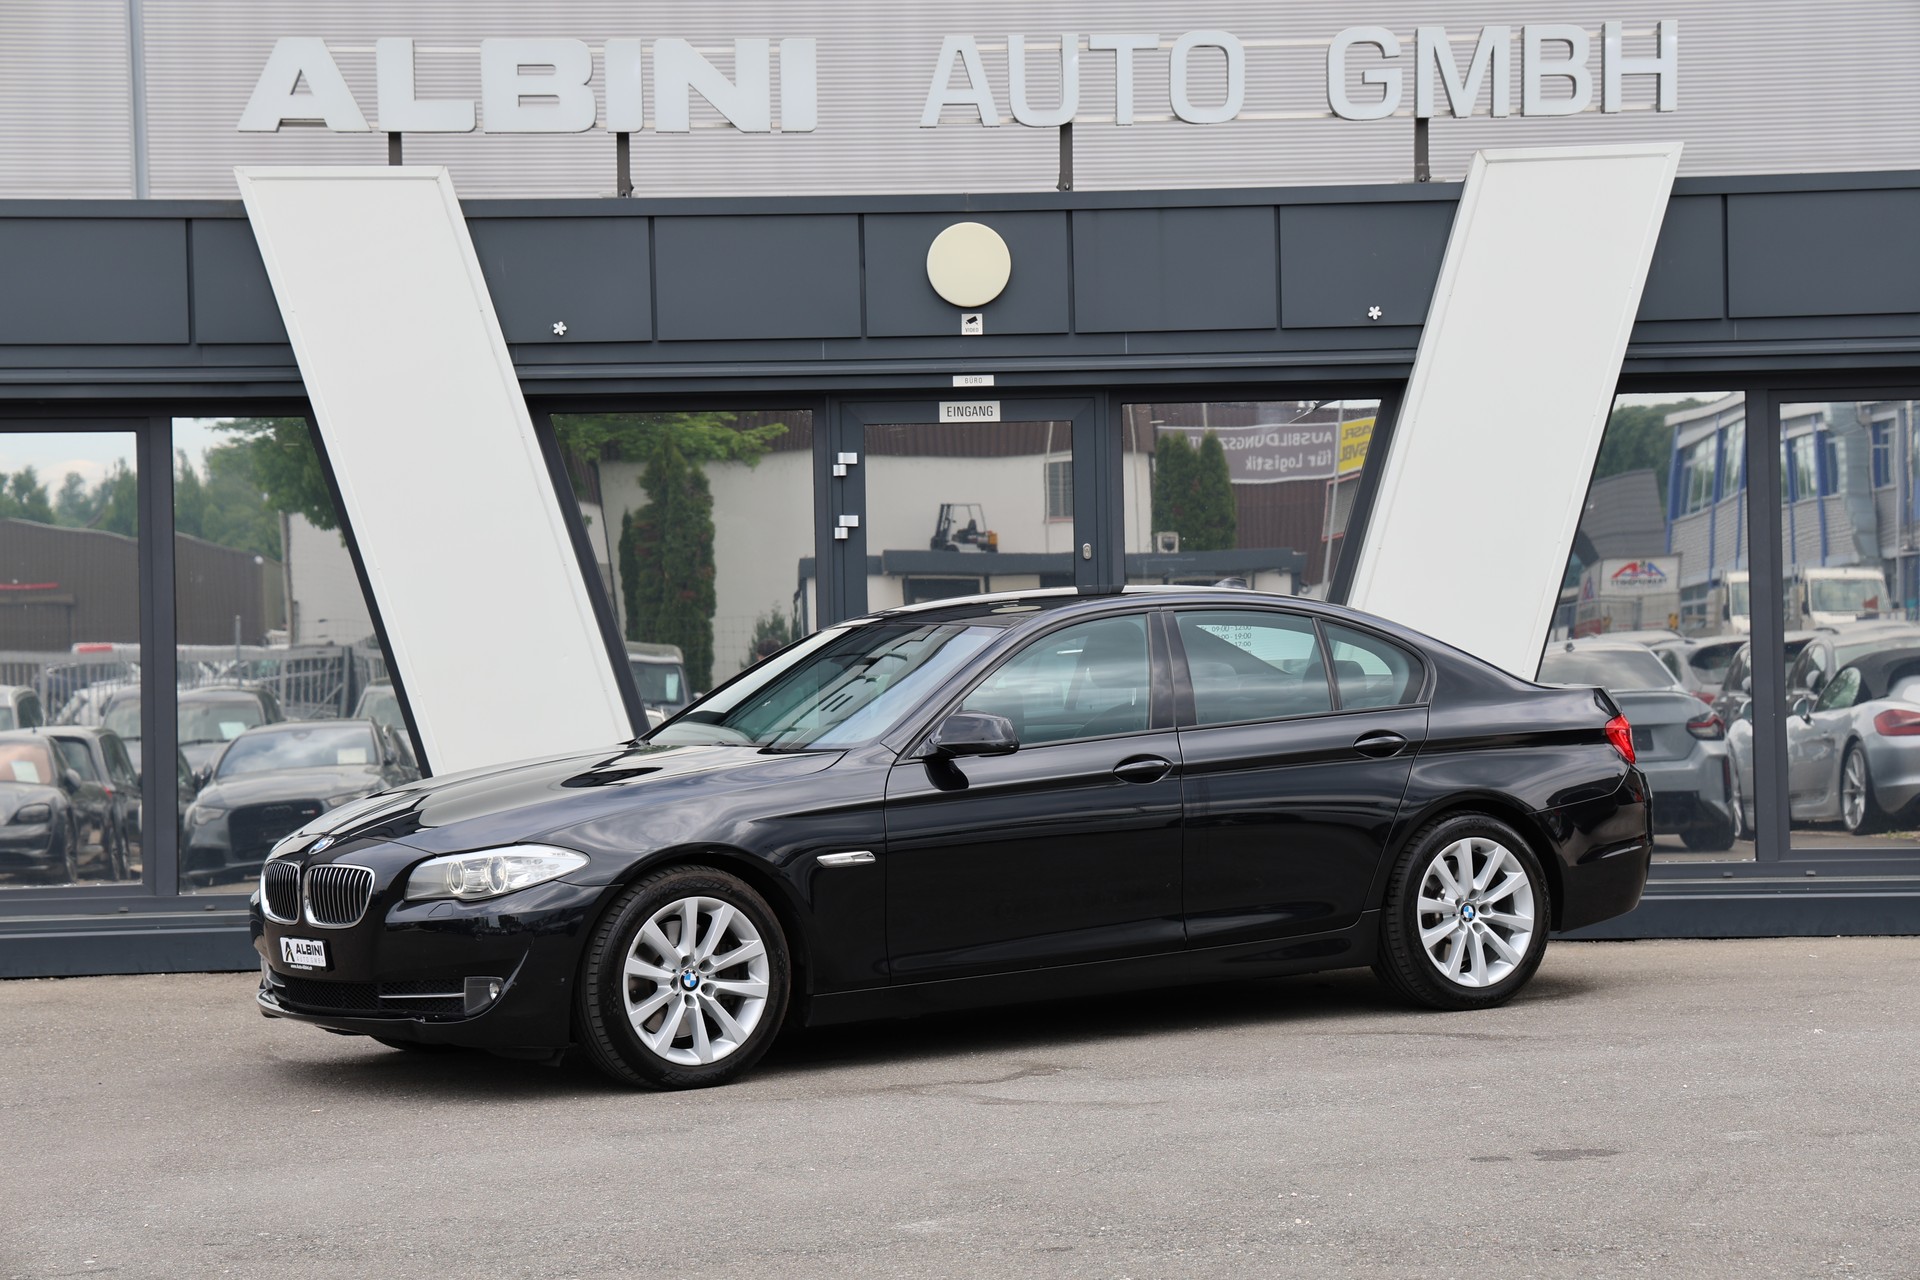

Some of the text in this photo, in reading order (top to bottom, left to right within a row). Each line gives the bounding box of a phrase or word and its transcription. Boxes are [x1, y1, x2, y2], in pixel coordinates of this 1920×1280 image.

[236, 19, 1679, 133] ALBINI AUTO GMBH
[964, 376, 983, 384] BÜRO
[946, 405, 994, 418] EINGANG
[296, 944, 322, 956] ALBINI
